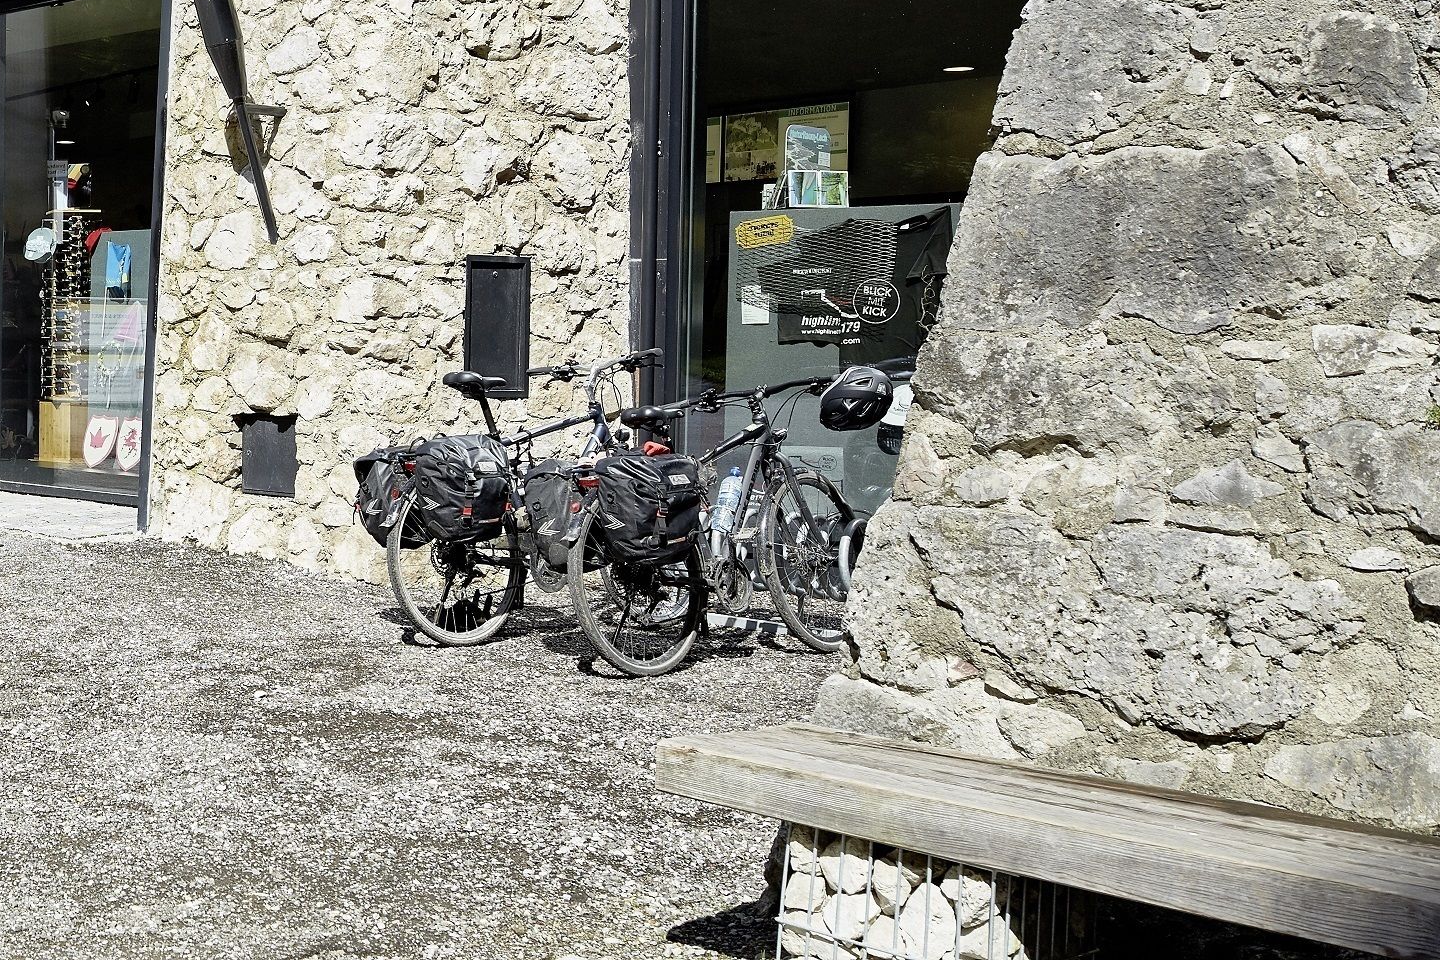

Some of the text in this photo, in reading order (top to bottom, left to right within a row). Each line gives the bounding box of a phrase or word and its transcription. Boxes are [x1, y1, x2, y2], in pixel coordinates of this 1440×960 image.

[789, 105, 837, 117] INFORMATION
[862, 305, 887, 318] KICK
[841, 321, 860, 334] 179
[840, 337, 860, 345] .com
